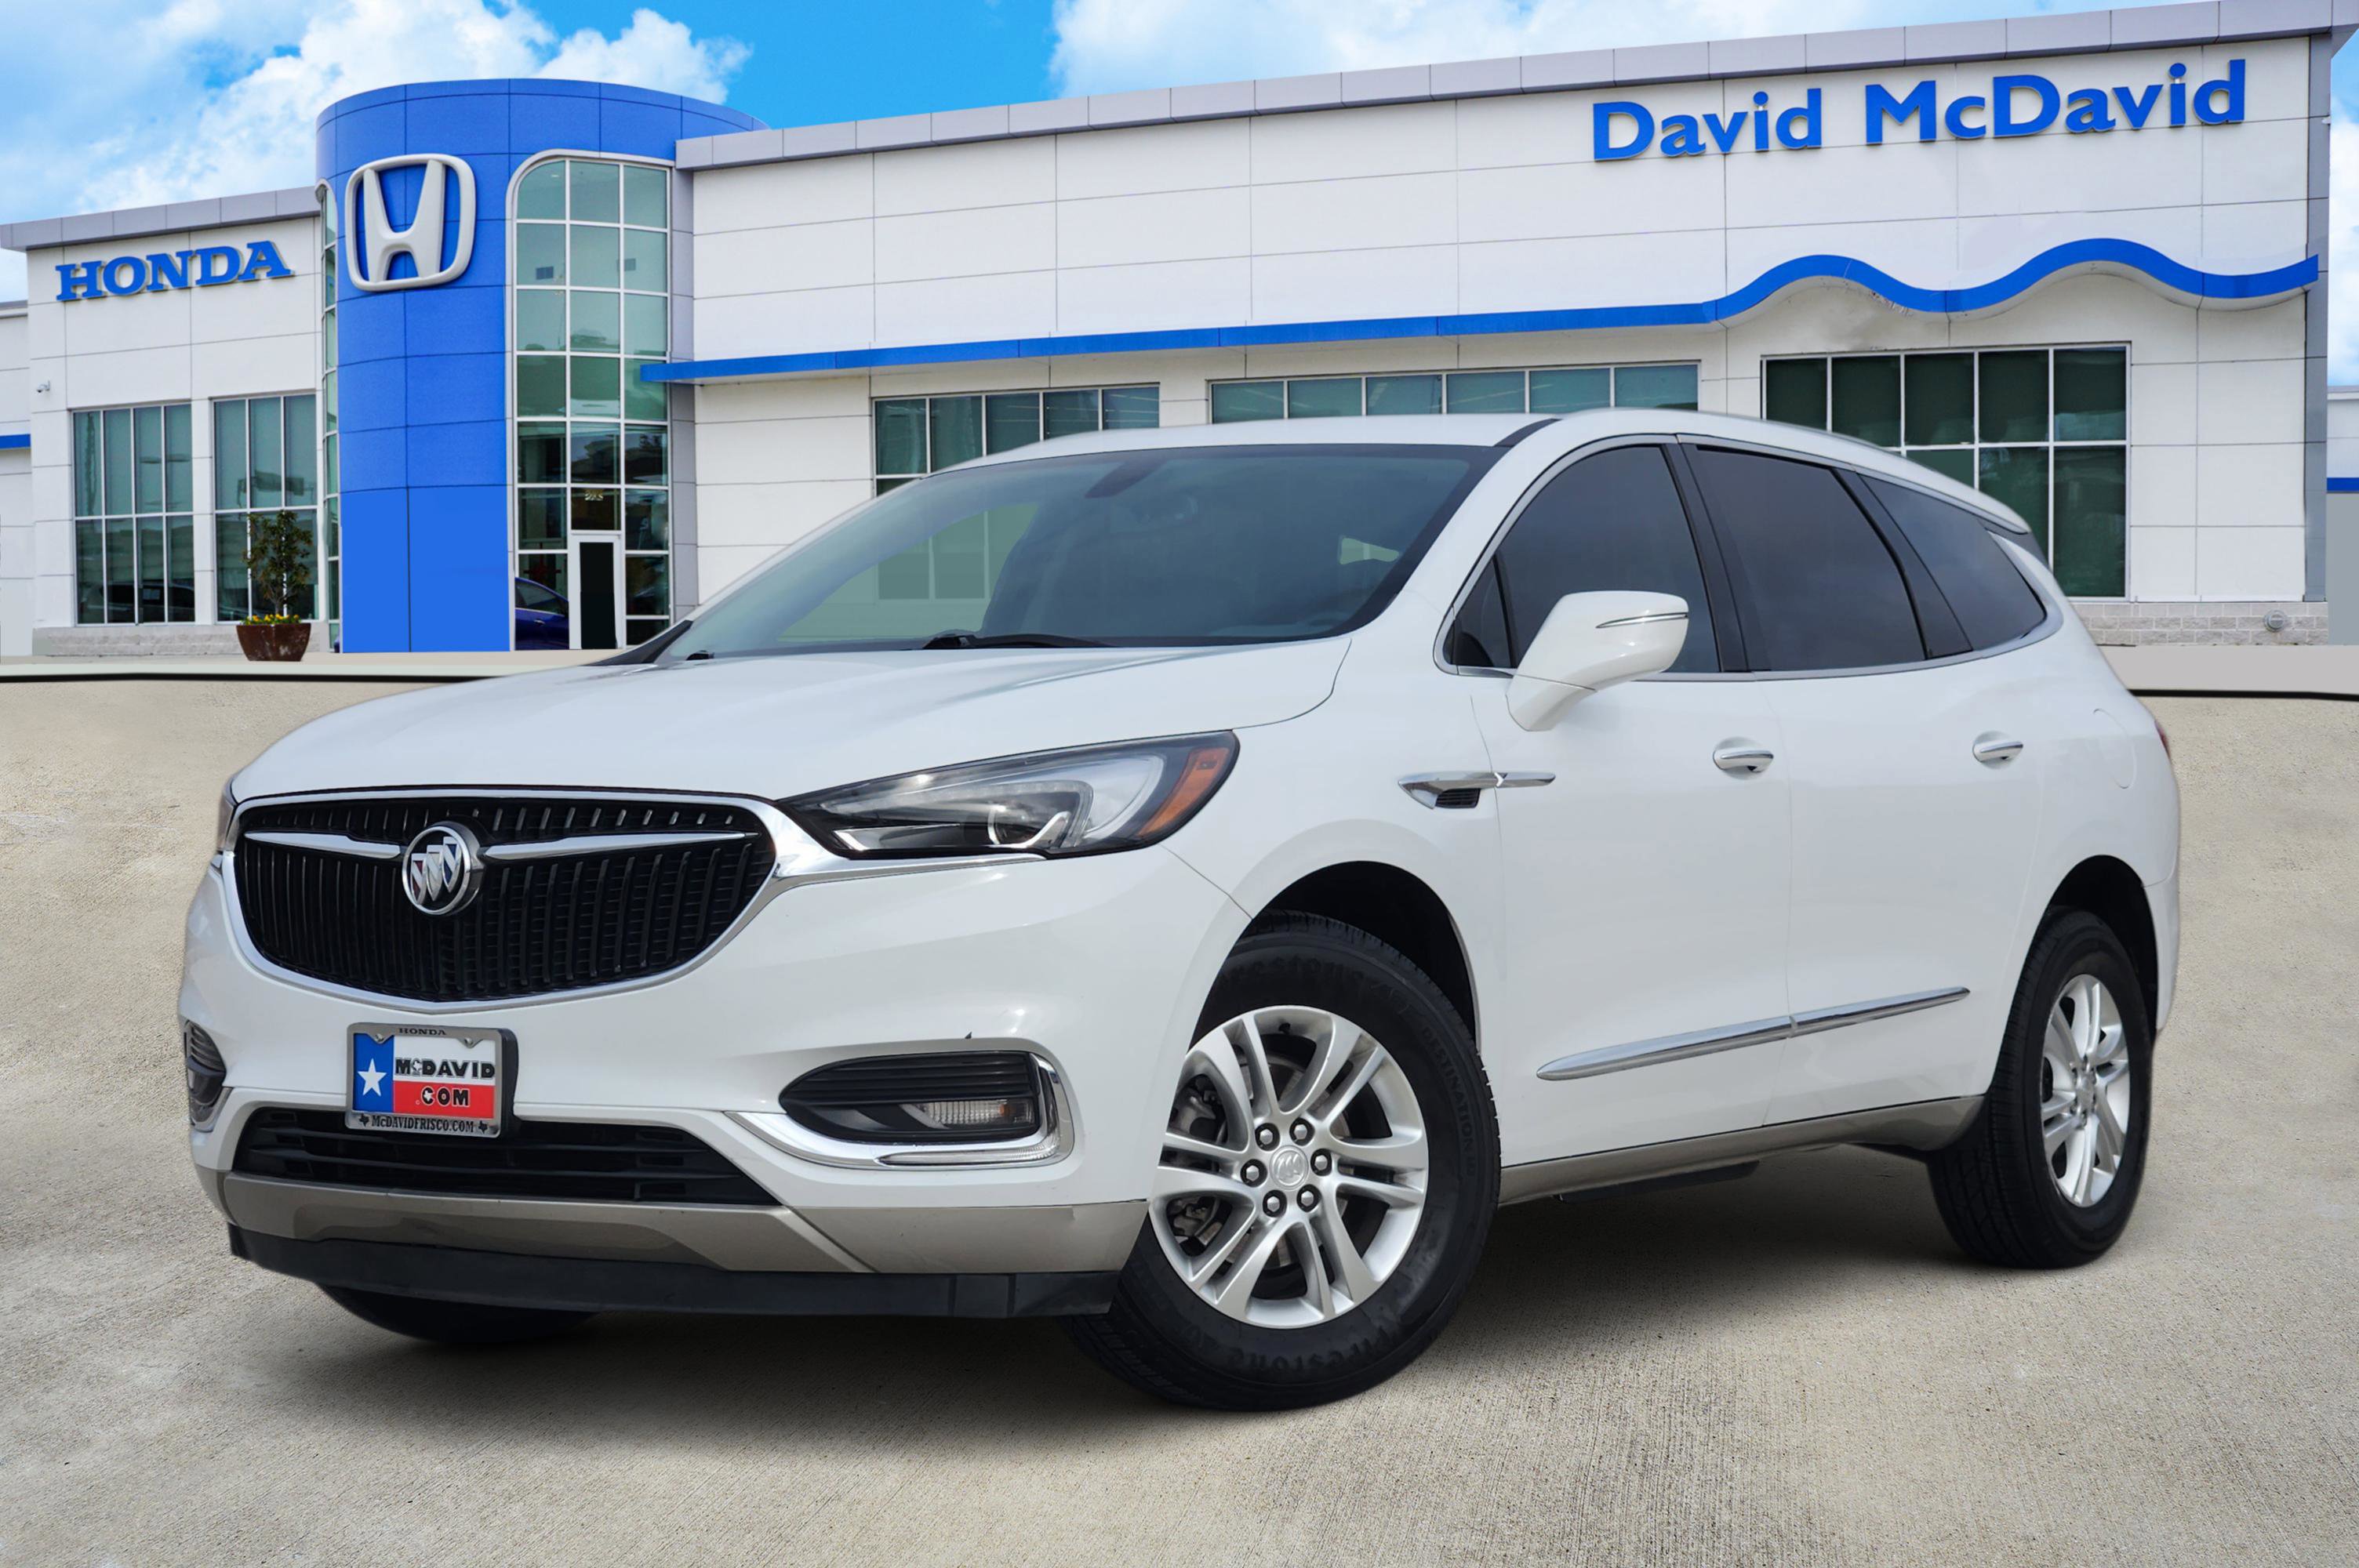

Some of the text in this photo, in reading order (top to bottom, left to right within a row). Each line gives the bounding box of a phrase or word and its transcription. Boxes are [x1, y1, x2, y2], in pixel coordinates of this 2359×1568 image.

[1593, 59, 2246, 162] David McDavid
[56, 241, 291, 302] HONDA
[371, 1116, 474, 1133] McDAVIDFRISCO.COM
